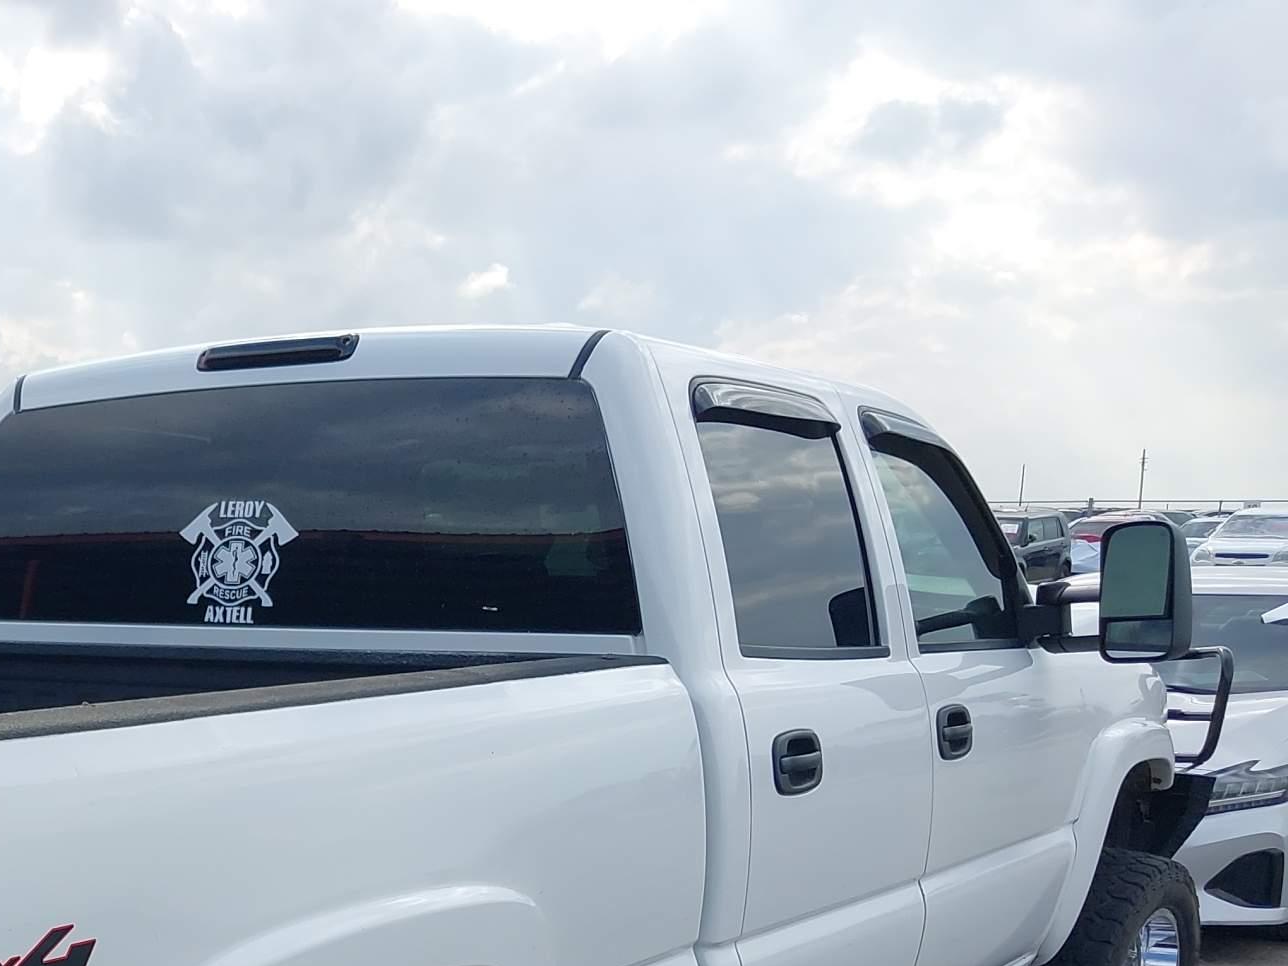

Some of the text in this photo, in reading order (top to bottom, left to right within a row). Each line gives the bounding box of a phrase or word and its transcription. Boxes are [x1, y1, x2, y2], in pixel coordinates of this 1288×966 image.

[219, 500, 265, 518] LEROY
[224, 525, 252, 537] FIRE
[213, 585, 249, 600] RESCUE
[204, 605, 254, 624] AXTELL
